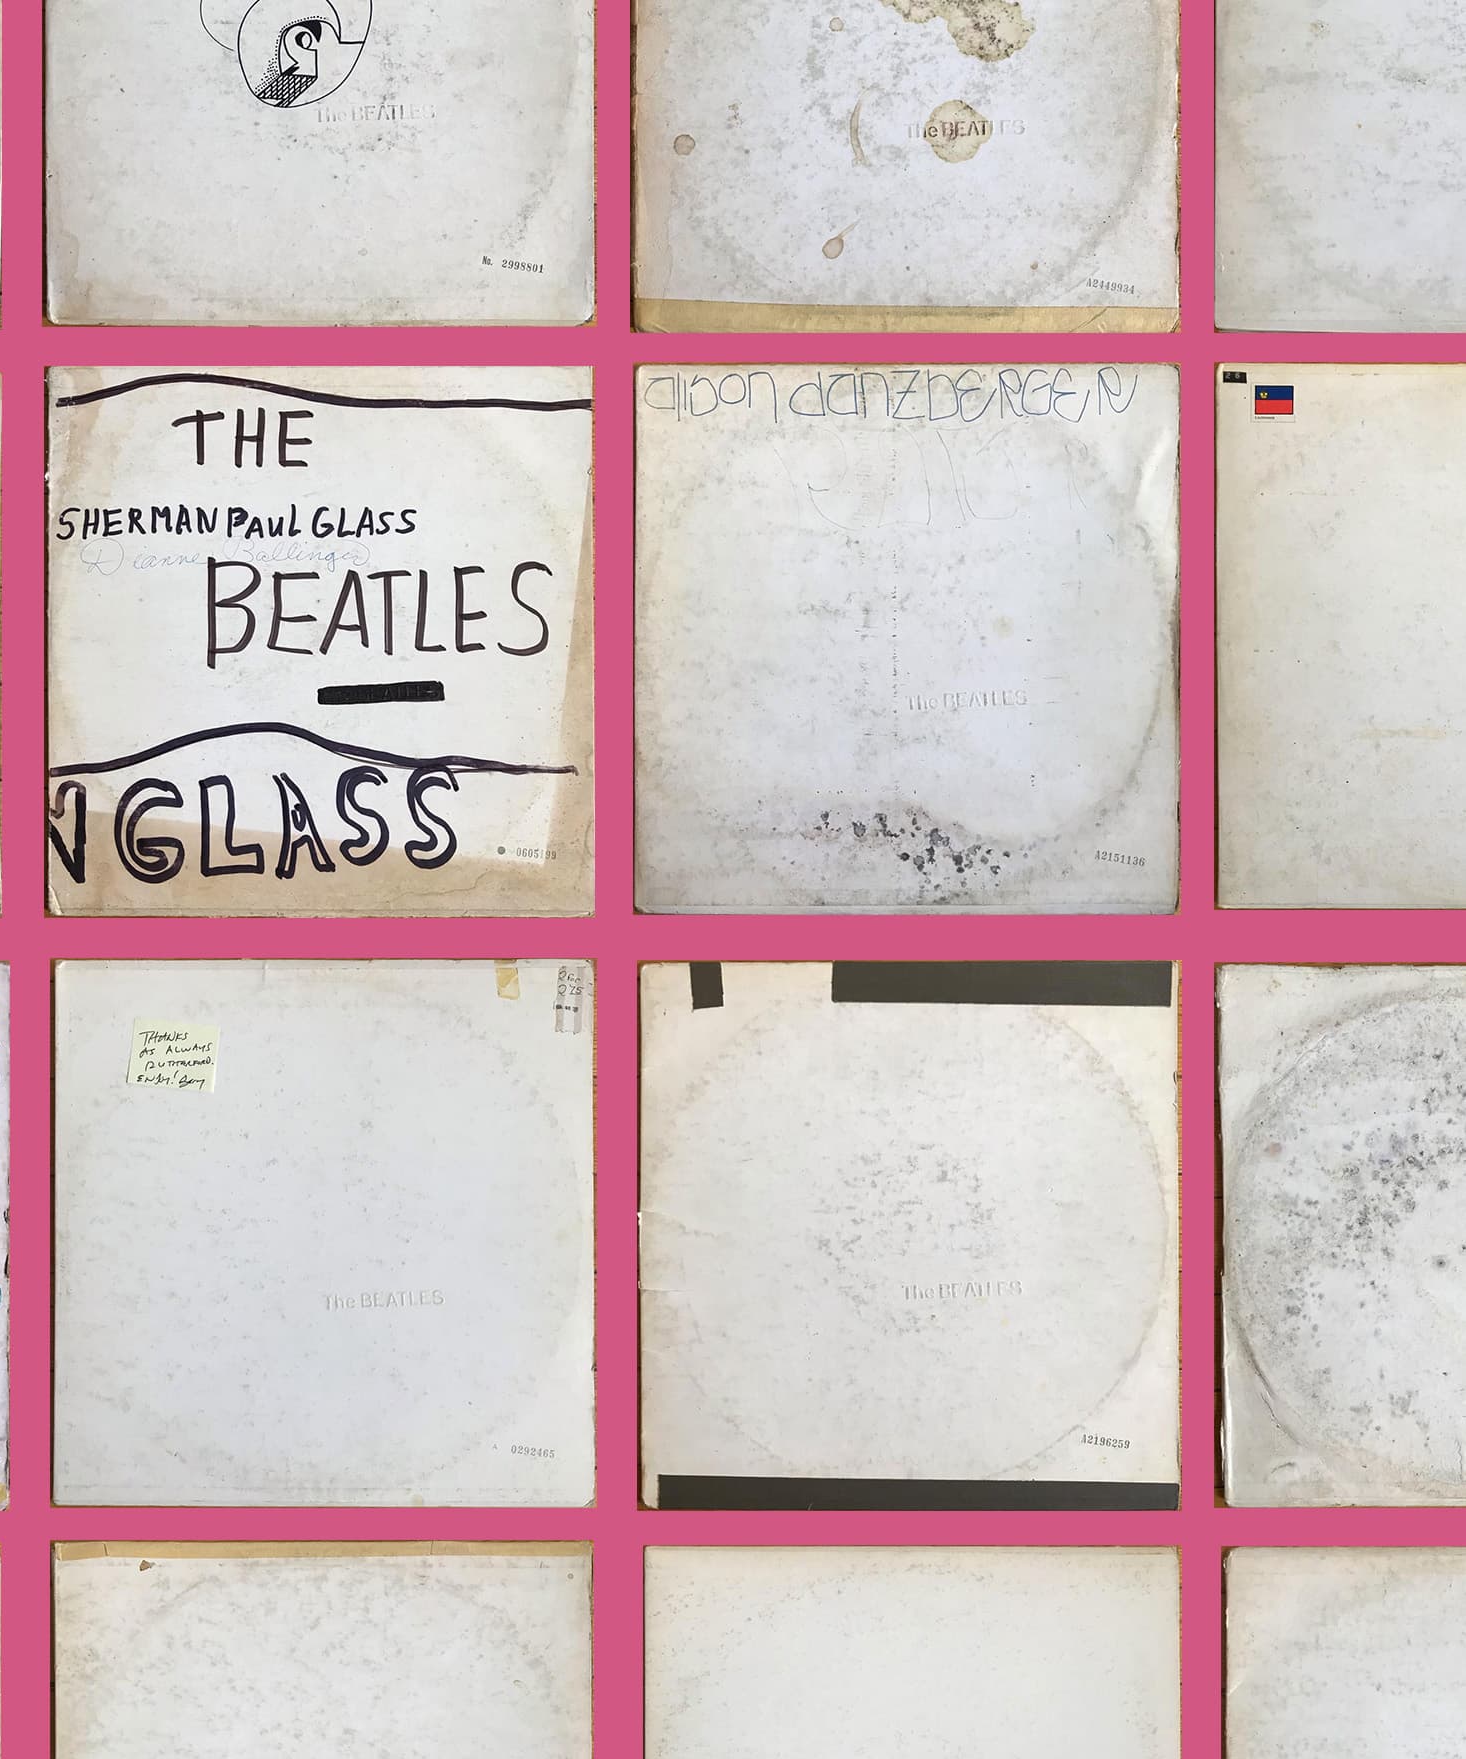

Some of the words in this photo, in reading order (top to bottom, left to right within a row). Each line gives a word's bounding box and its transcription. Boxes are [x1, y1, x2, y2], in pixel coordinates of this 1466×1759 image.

[316, 107, 347, 124] The
[351, 103, 438, 122] BEATLES
[905, 120, 938, 139] The
[941, 119, 1026, 138] BEATLES
[500, 258, 544, 275] 2998801
[171, 406, 315, 468] THE
[56, 506, 219, 541] SHERMAN
[311, 506, 418, 539] GLASS
[207, 556, 554, 669] BEATLES
[904, 694, 939, 711] The
[942, 689, 1028, 709] BEATLES
[114, 765, 460, 885] GLASS
[1094, 849, 1146, 867] A2151136
[325, 1294, 357, 1312] The
[360, 1289, 445, 1310] BEATLES
[903, 1283, 936, 1301] The
[938, 1279, 1023, 1300] BEATLES
